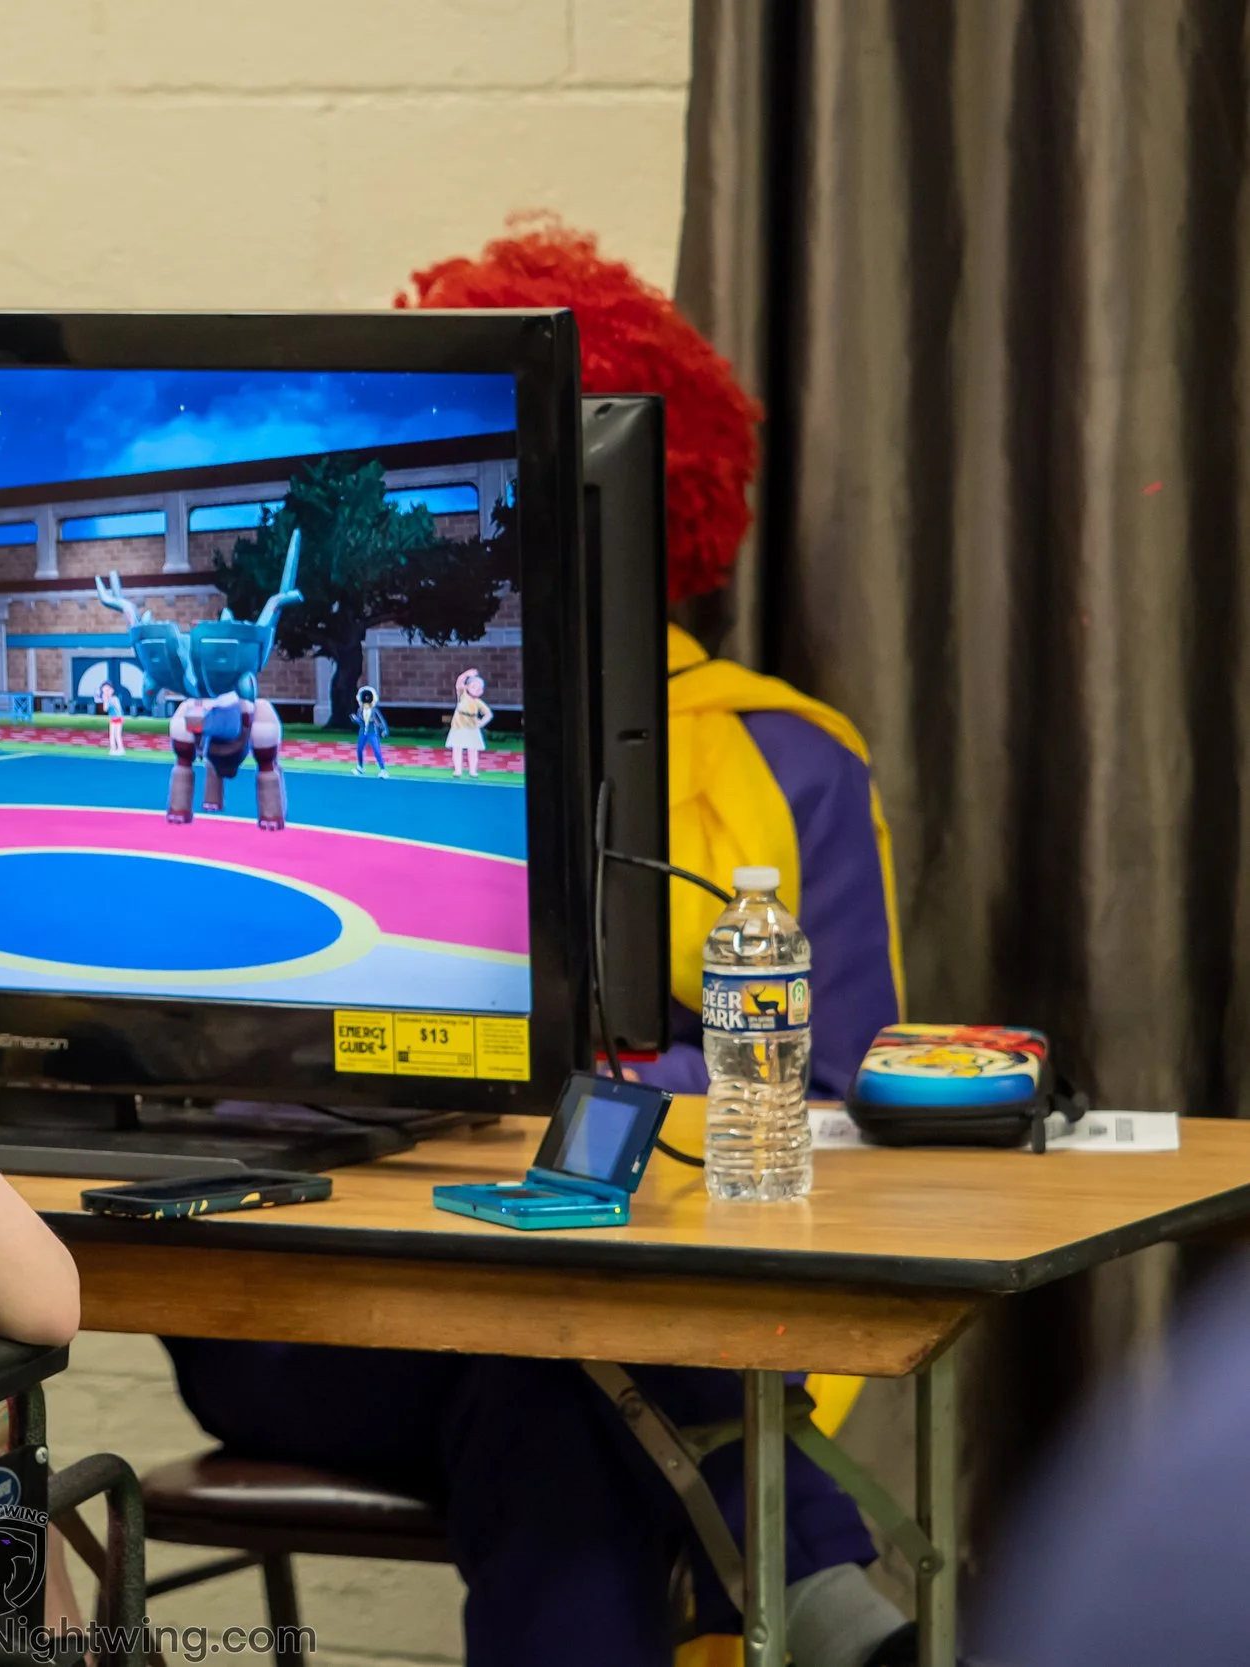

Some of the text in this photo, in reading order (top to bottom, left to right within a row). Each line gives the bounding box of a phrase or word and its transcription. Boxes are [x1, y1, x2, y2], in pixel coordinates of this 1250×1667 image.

[702, 987, 742, 1009] DEER
[702, 1006, 745, 1030] PARK
[420, 1028, 449, 1044] $13
